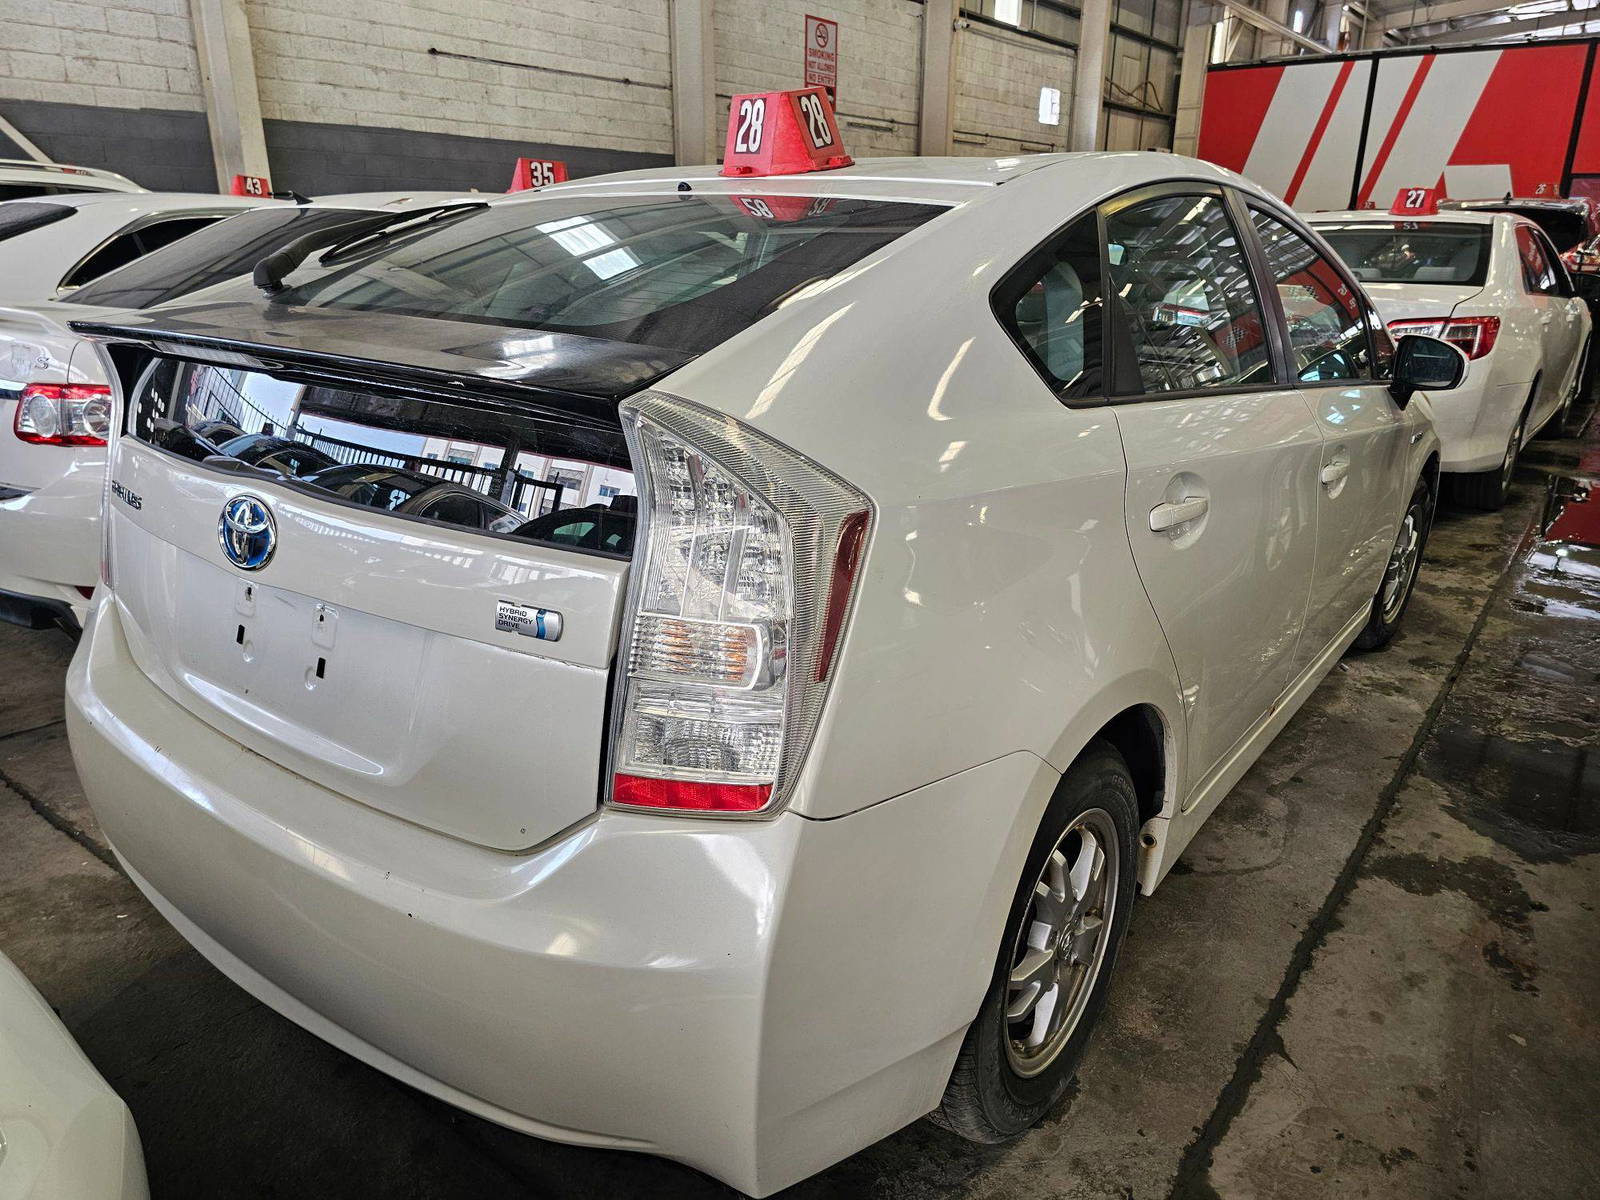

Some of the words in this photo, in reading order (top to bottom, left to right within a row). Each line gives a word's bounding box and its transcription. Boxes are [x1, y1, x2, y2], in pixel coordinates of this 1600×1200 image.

[808, 47, 834, 62] SMOKING
[808, 72, 817, 82] NO
[817, 74, 835, 87] ENTRY
[735, 98, 765, 153] 28
[800, 94, 832, 148] 28
[530, 161, 555, 187] 35
[246, 177, 262, 195] 43
[1405, 190, 1425, 208] 27
[498, 612, 534, 625] SYNERGY
[499, 606, 528, 617] HYBRID
[497, 619, 520, 629] DRIVE
